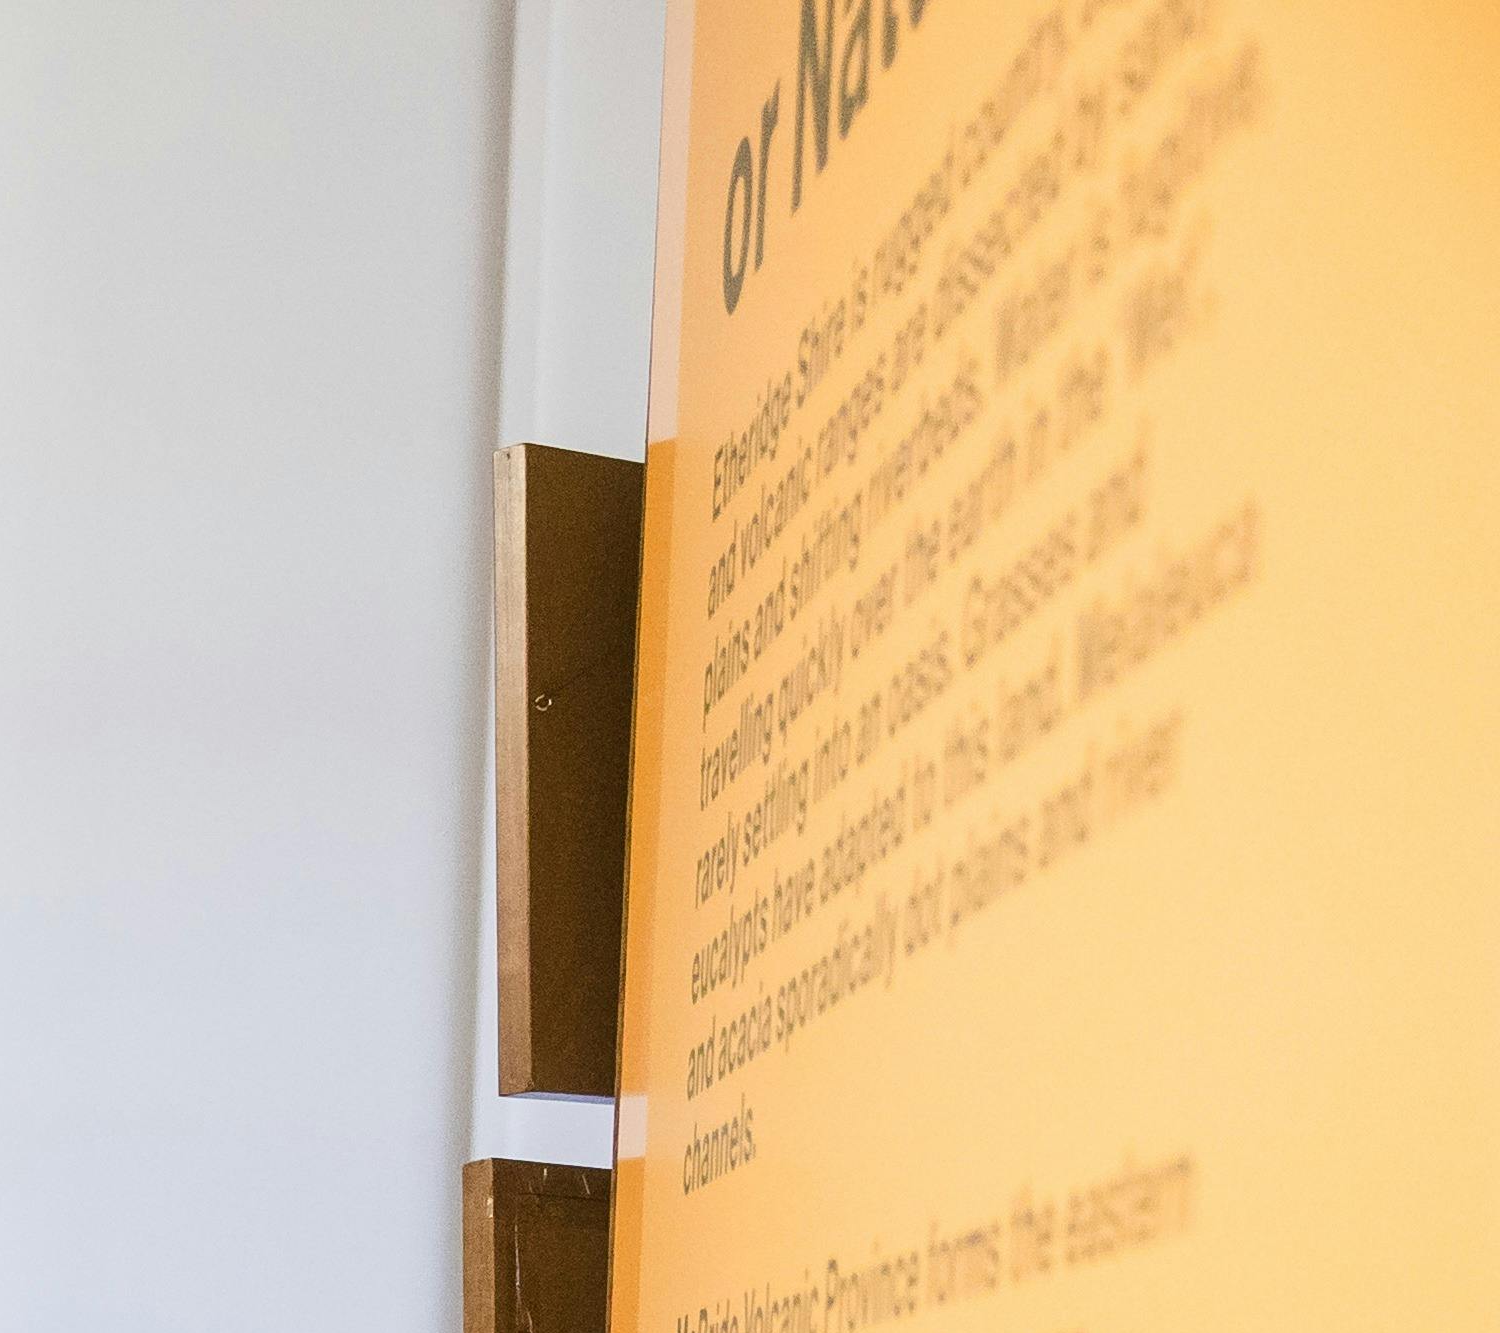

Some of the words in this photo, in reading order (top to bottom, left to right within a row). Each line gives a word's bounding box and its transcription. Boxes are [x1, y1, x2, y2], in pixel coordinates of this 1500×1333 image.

[722, 78, 780, 316] or
[707, 516, 737, 618] and
[739, 431, 812, 579] volcanic
[816, 339, 885, 485] ranges
[711, 360, 792, 521] Etheridge
[796, 285, 845, 408] Shire
[849, 252, 868, 337] is
[698, 681, 774, 812] travelling
[777, 602, 844, 751] quickly
[848, 550, 897, 662] over
[903, 500, 940, 607] the
[702, 607, 751, 730] plains
[753, 550, 787, 658] and
[789, 476, 862, 618] shifting
[690, 883, 769, 1005] eucalypts
[772, 848, 815, 942] have
[819, 752, 909, 905] adapted
[912, 743, 936, 833] to
[694, 808, 739, 909] rarely
[742, 748, 809, 866] settling
[812, 706, 852, 804] into
[855, 678, 882, 765] an
[686, 1011, 716, 1100] and
[717, 976, 772, 1080] acacia
[775, 885, 898, 1053] sporadically
[682, 1090, 757, 1197] channels.
